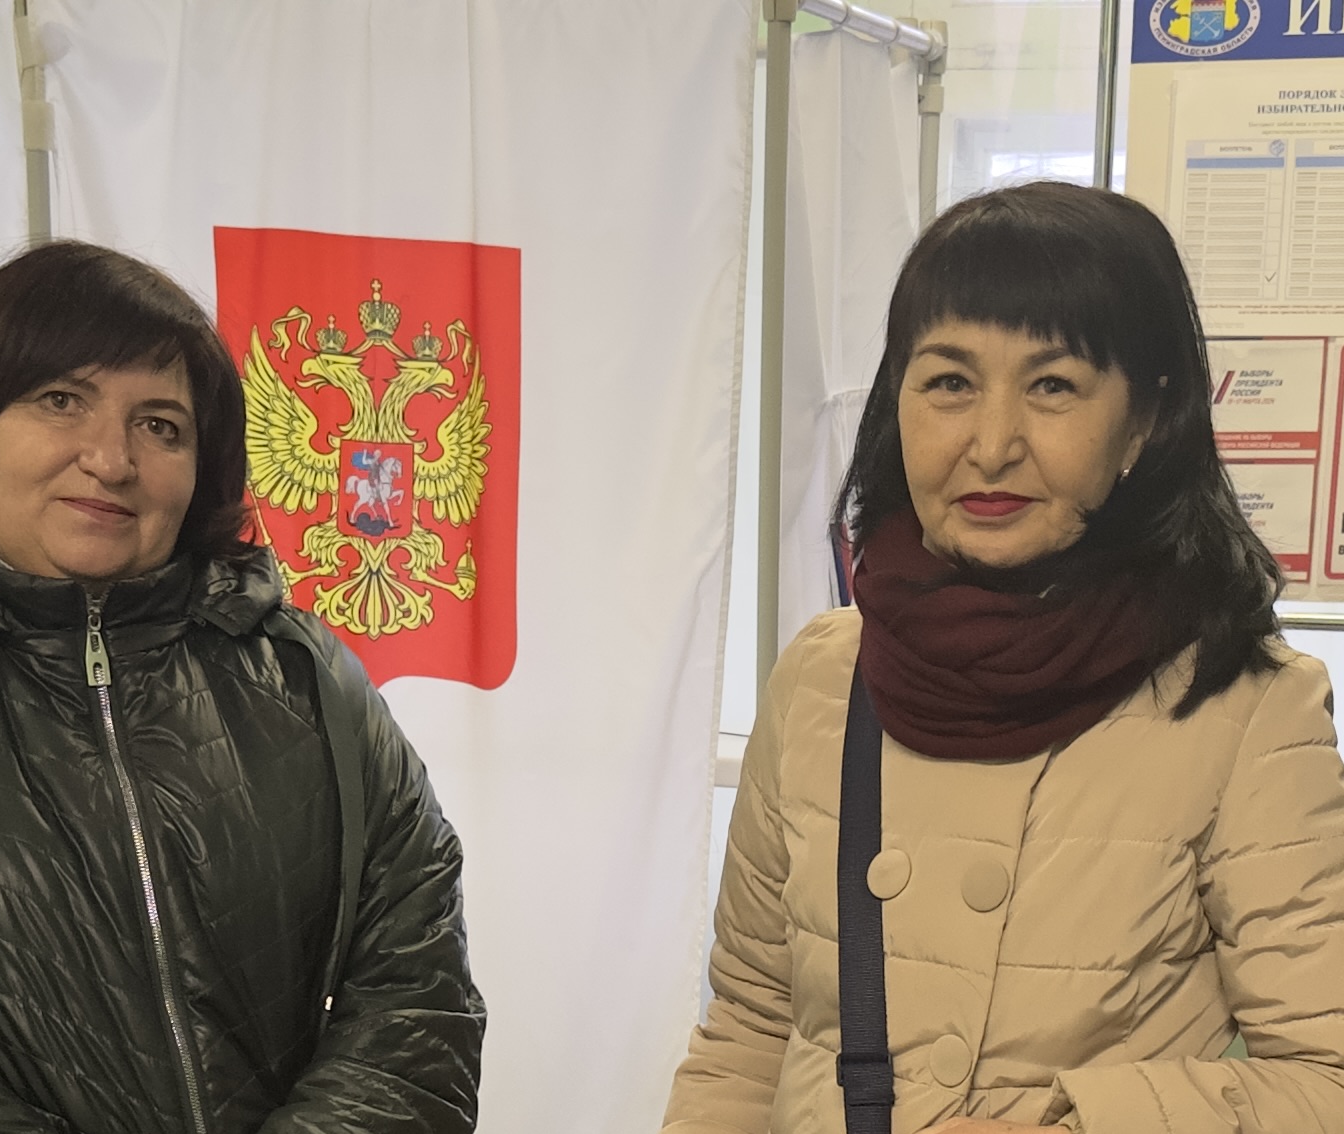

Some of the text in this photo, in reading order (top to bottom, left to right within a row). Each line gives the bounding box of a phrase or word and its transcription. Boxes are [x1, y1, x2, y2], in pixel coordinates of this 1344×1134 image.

[1154, 26, 1254, 55] ЛЕНИНГРАДСКАЯ ОБЛАСТЬ
[1278, 89, 1337, 100] ПОРЯДОК
